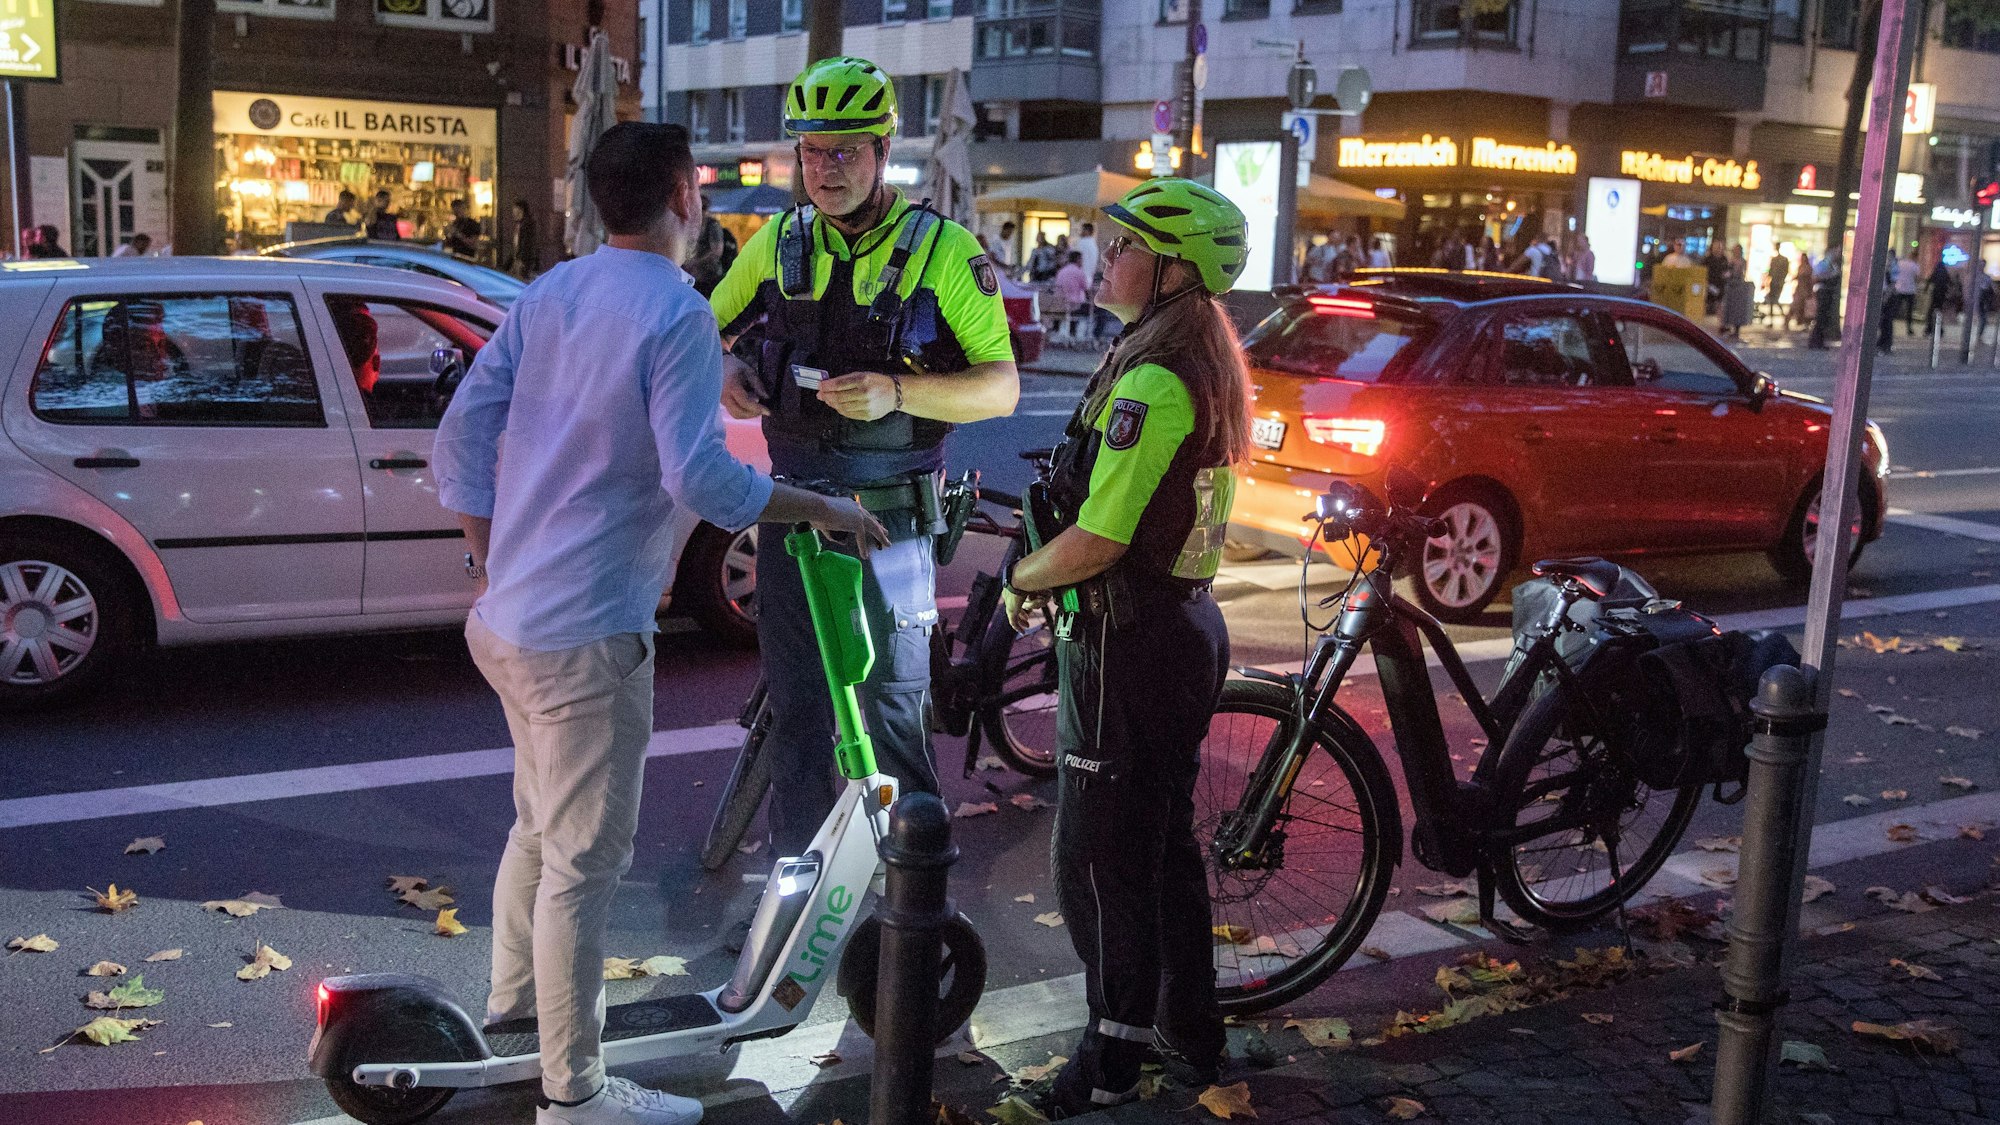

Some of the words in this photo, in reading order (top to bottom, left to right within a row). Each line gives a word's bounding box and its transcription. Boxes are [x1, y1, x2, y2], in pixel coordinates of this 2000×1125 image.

[290, 112, 330, 129] Café
[335, 111, 356, 130] IL
[365, 112, 469, 137] BARISTA
[1338, 133, 1458, 168] Merzenich
[1471, 136, 1577, 175] Merzenich
[1114, 400, 1144, 415] POLIZEI
[1064, 753, 1101, 773] POLIZEI
[789, 885, 853, 983] Lime
